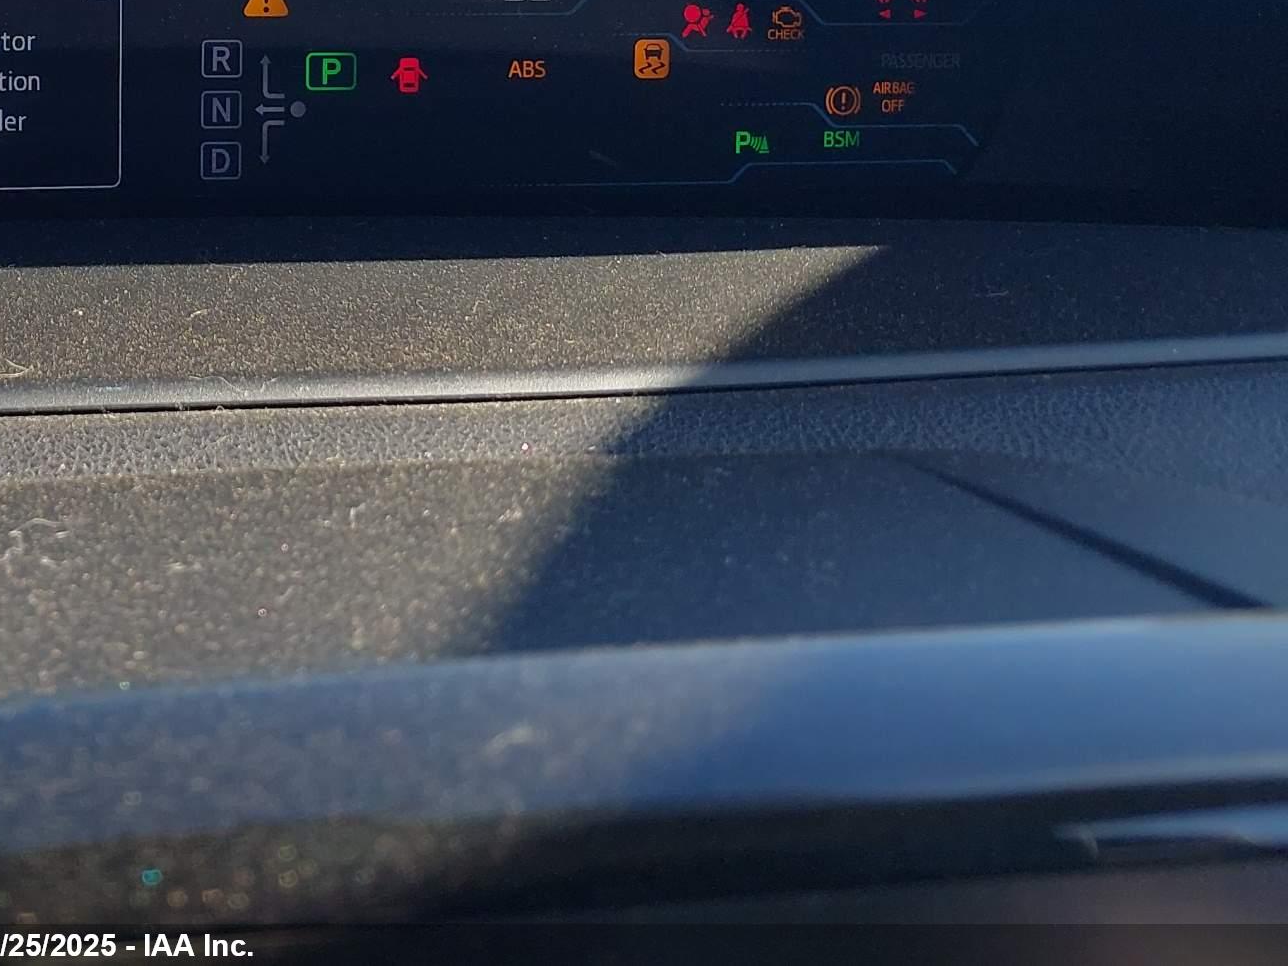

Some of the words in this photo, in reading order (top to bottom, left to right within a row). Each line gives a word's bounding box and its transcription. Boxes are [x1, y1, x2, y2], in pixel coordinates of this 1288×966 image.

[767, 28, 805, 40] CHECK
[213, 46, 230, 71] R
[880, 52, 961, 69] PASSENGER
[323, 58, 341, 84] P
[509, 61, 545, 77] ABS
[872, 81, 916, 95] AIRBAG
[212, 98, 230, 122] N
[881, 99, 905, 113] OFF
[824, 131, 859, 147] BSM
[212, 149, 230, 173] D
